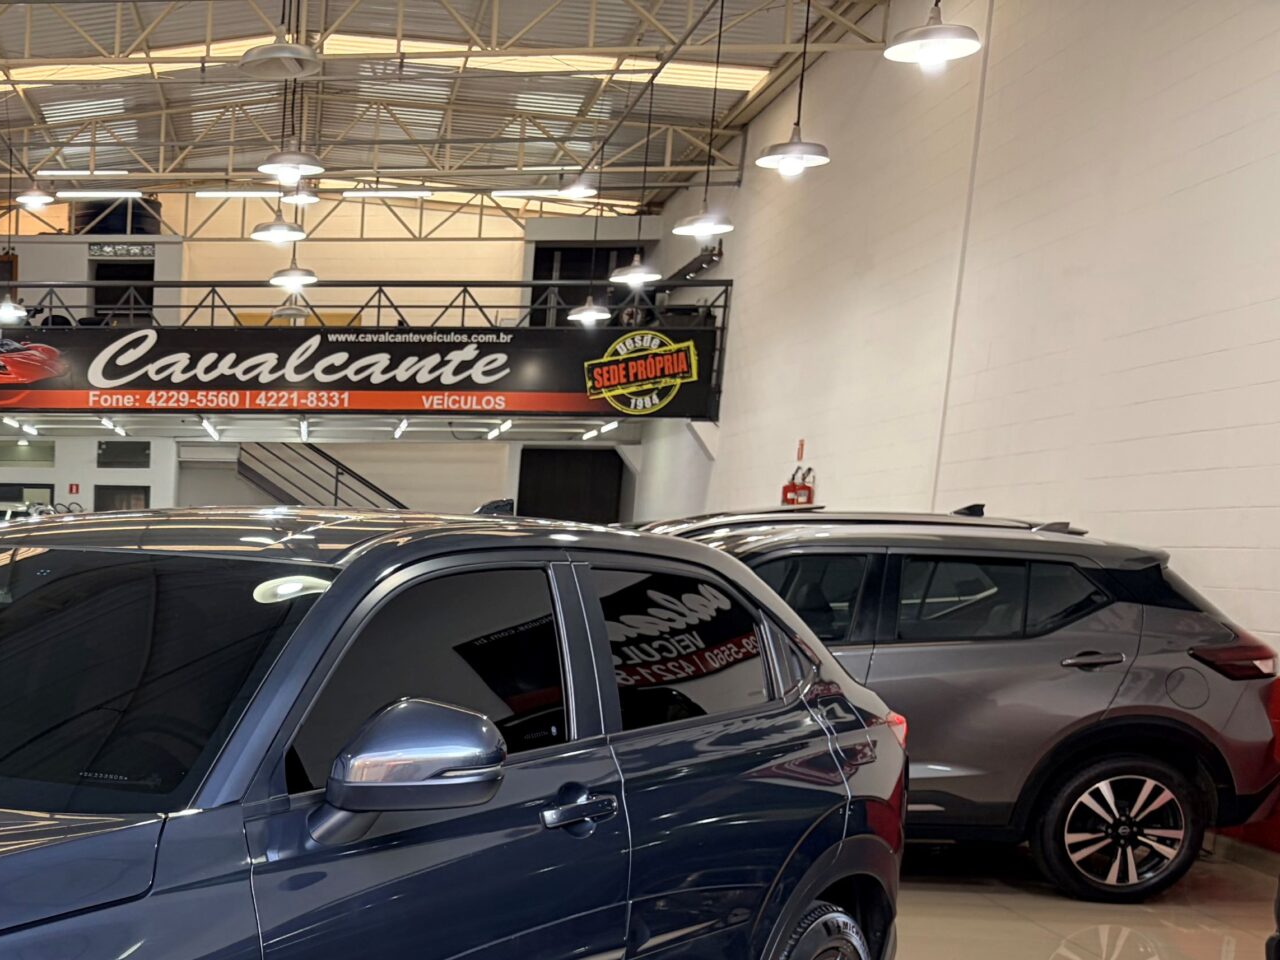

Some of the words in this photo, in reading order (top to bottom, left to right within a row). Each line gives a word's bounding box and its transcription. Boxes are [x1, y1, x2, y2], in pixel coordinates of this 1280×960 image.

[327, 332, 513, 343] www.cavalcanteveiculos.com.br
[87, 328, 511, 389] Cavalcante
[593, 363, 628, 389] SEDE
[628, 352, 688, 381] PRÓPRIA
[88, 391, 140, 407] Fone:
[145, 391, 240, 407] 4229-5560
[255, 391, 350, 408] 4221-8331
[421, 392, 506, 409] VEÍCULOS
[629, 393, 660, 410] 1984
